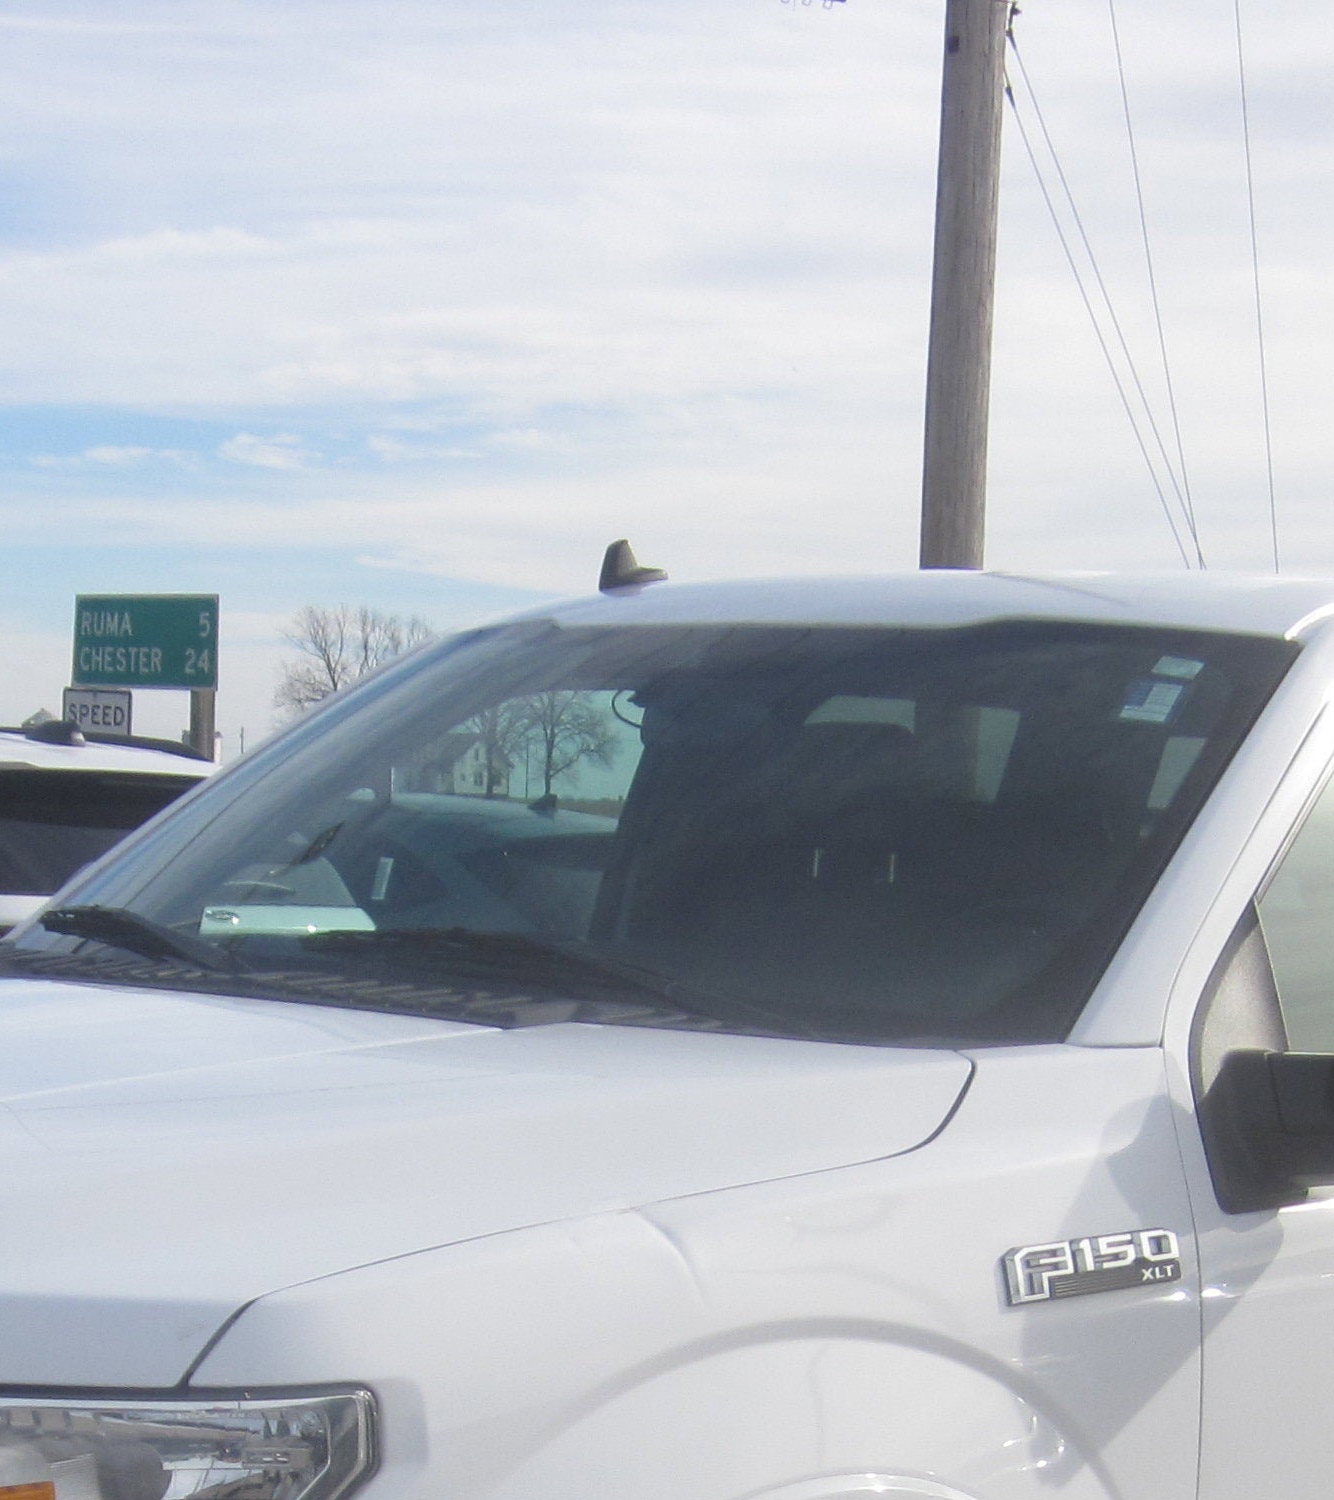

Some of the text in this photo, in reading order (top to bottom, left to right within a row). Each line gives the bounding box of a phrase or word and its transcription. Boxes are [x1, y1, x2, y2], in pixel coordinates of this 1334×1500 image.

[80, 611, 211, 637] RUMA 5
[79, 646, 210, 675] CHESTER 24
[69, 703, 125, 726] SPEED
[1140, 1263, 1175, 1282] XLT
